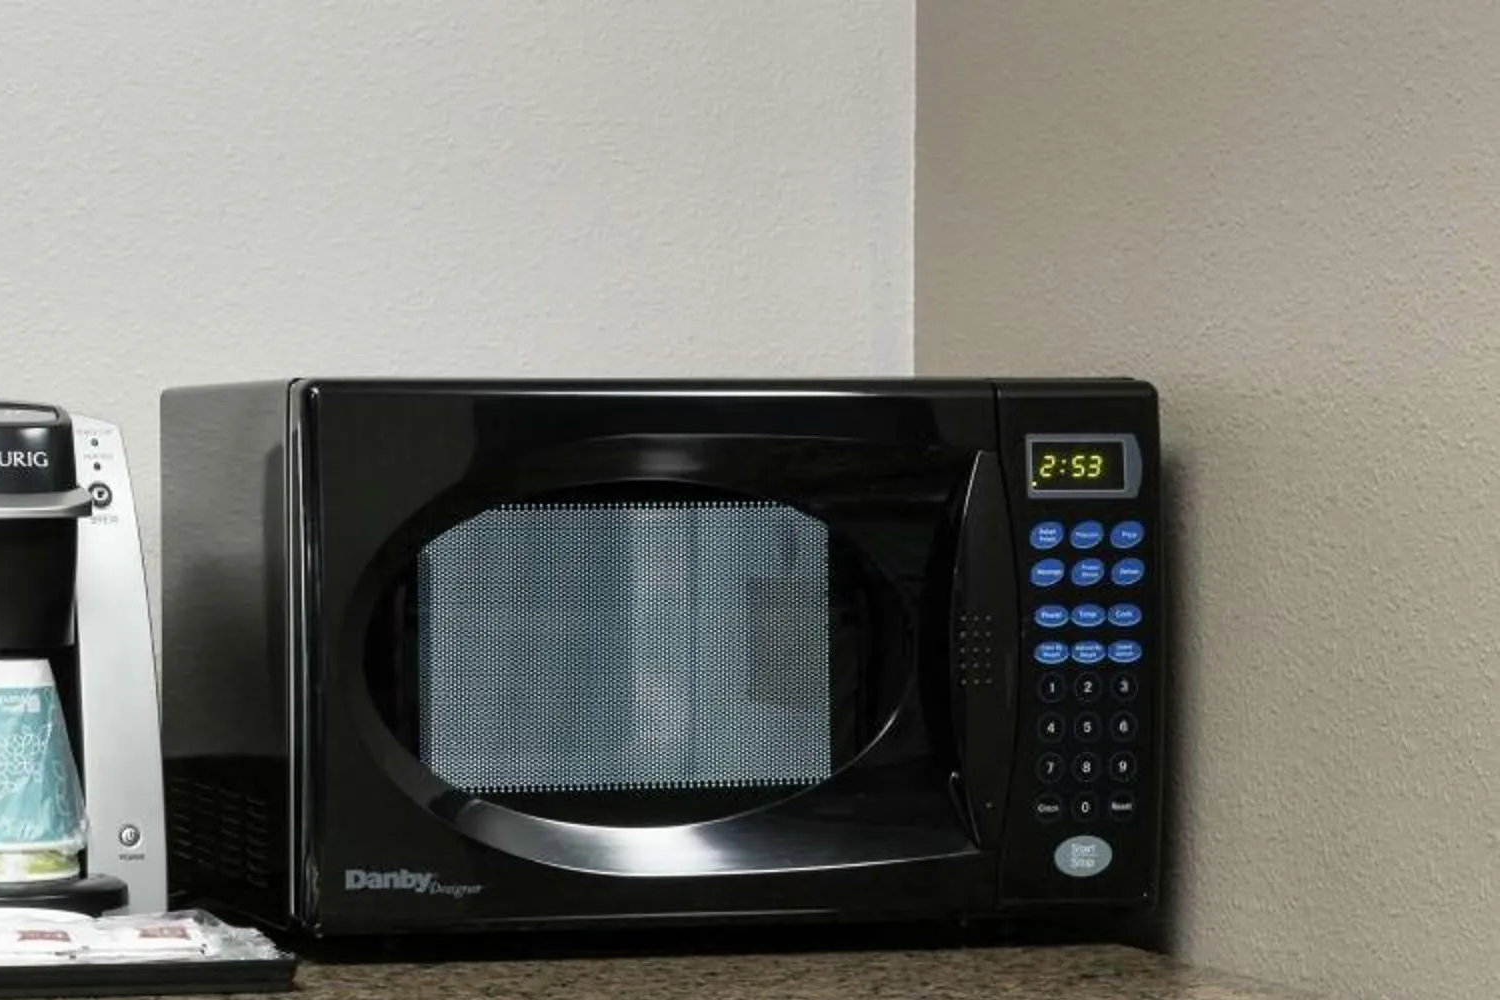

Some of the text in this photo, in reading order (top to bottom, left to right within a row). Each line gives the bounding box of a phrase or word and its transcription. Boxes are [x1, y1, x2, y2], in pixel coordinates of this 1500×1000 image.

[1039, 454, 1103, 478] 2:53
[1050, 682, 1055, 693] 1
[1083, 681, 1093, 693] 2
[1120, 680, 1129, 692] 3
[1047, 722, 1055, 733] 4
[1083, 721, 1092, 733] 5
[1119, 720, 1128, 733] 6
[1047, 761, 1055, 774] 7
[1082, 761, 1091, 773] 8
[1118, 761, 1128, 772] 9
[1081, 801, 1090, 813] 0
[345, 869, 434, 893] Danby
